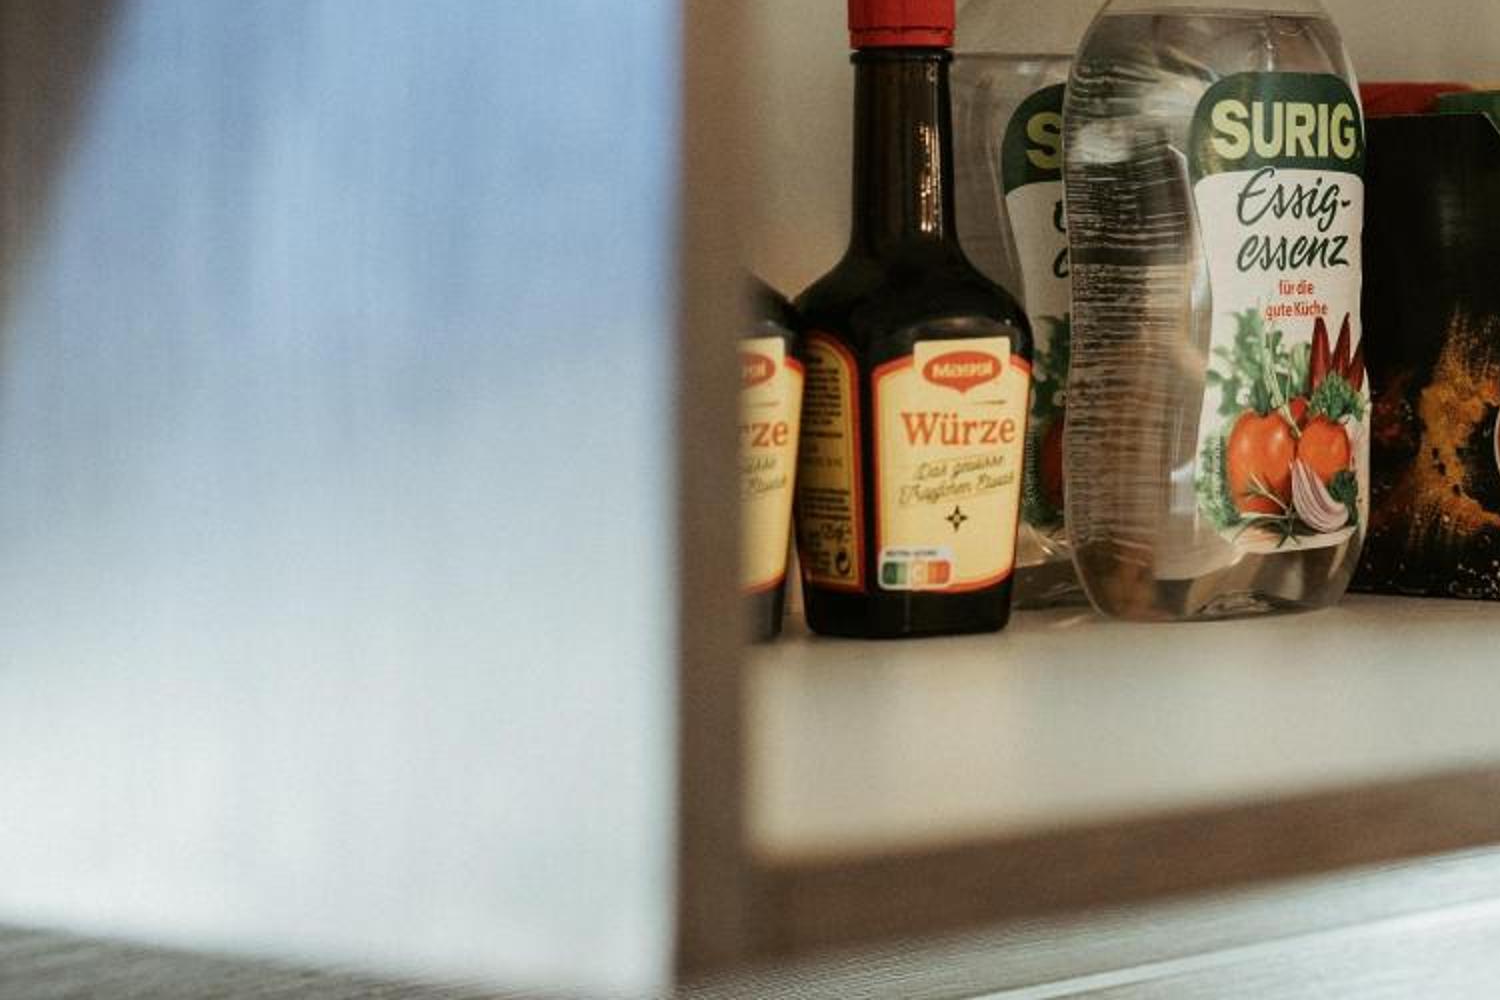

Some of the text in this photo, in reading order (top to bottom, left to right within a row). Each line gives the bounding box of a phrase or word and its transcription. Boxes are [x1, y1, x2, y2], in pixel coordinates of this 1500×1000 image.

[1211, 99, 1356, 160] SURIG
[1236, 166, 1351, 233] Essig-
[1237, 234, 1349, 273] essenz
[1279, 280, 1313, 295] für die
[1265, 300, 1328, 321] gute Küche
[900, 410, 1016, 446] Würze
